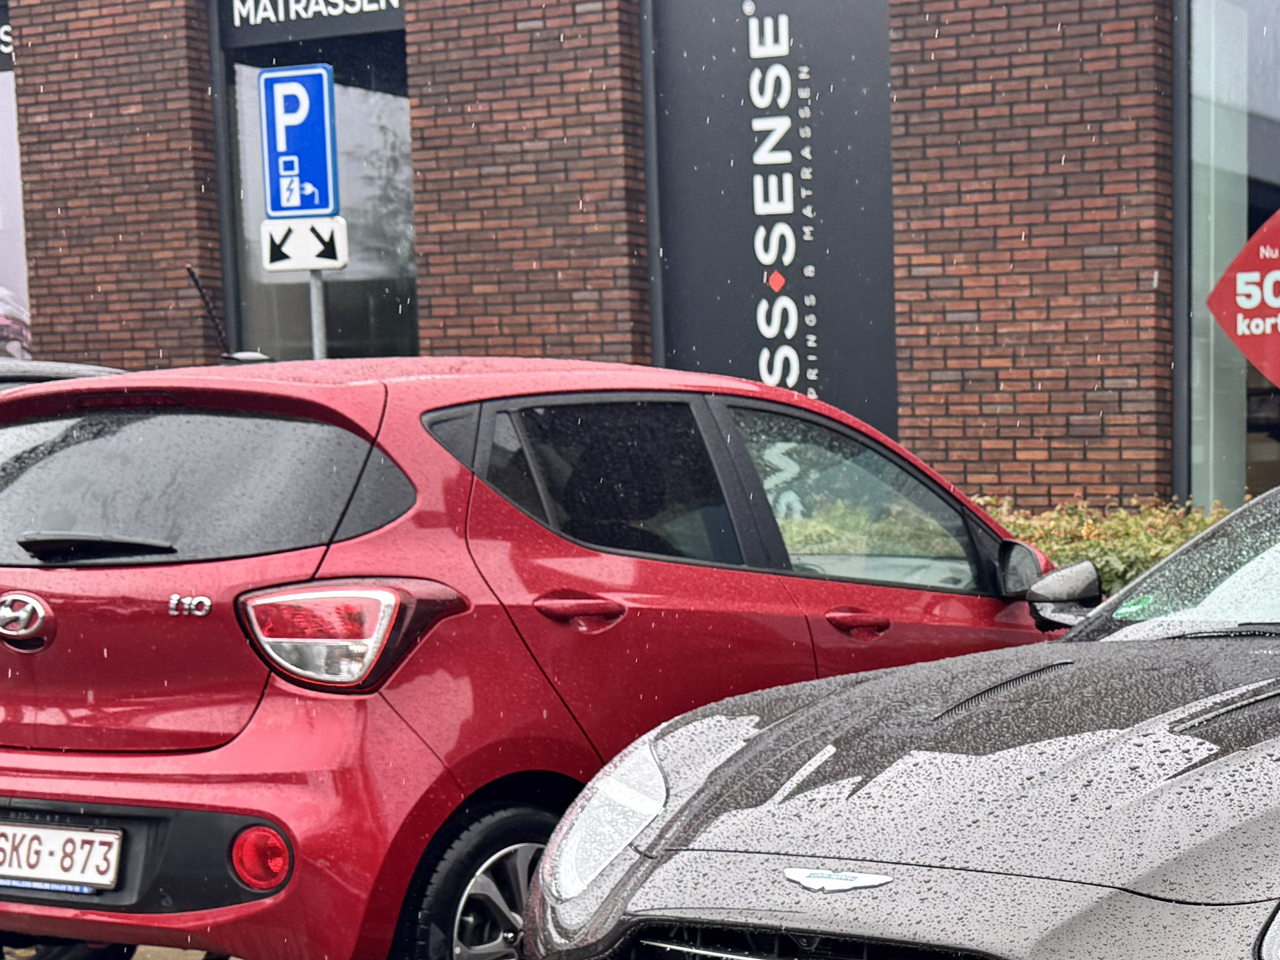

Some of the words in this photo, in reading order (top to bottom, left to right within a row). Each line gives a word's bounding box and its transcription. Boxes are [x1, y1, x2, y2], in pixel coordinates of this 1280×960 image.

[272, 81, 310, 153] P
[797, 65, 818, 241] MATRASSEN
[1259, 245, 1279, 260] Nu
[803, 294, 819, 400] PRINGS
[168, 593, 213, 617] i10
